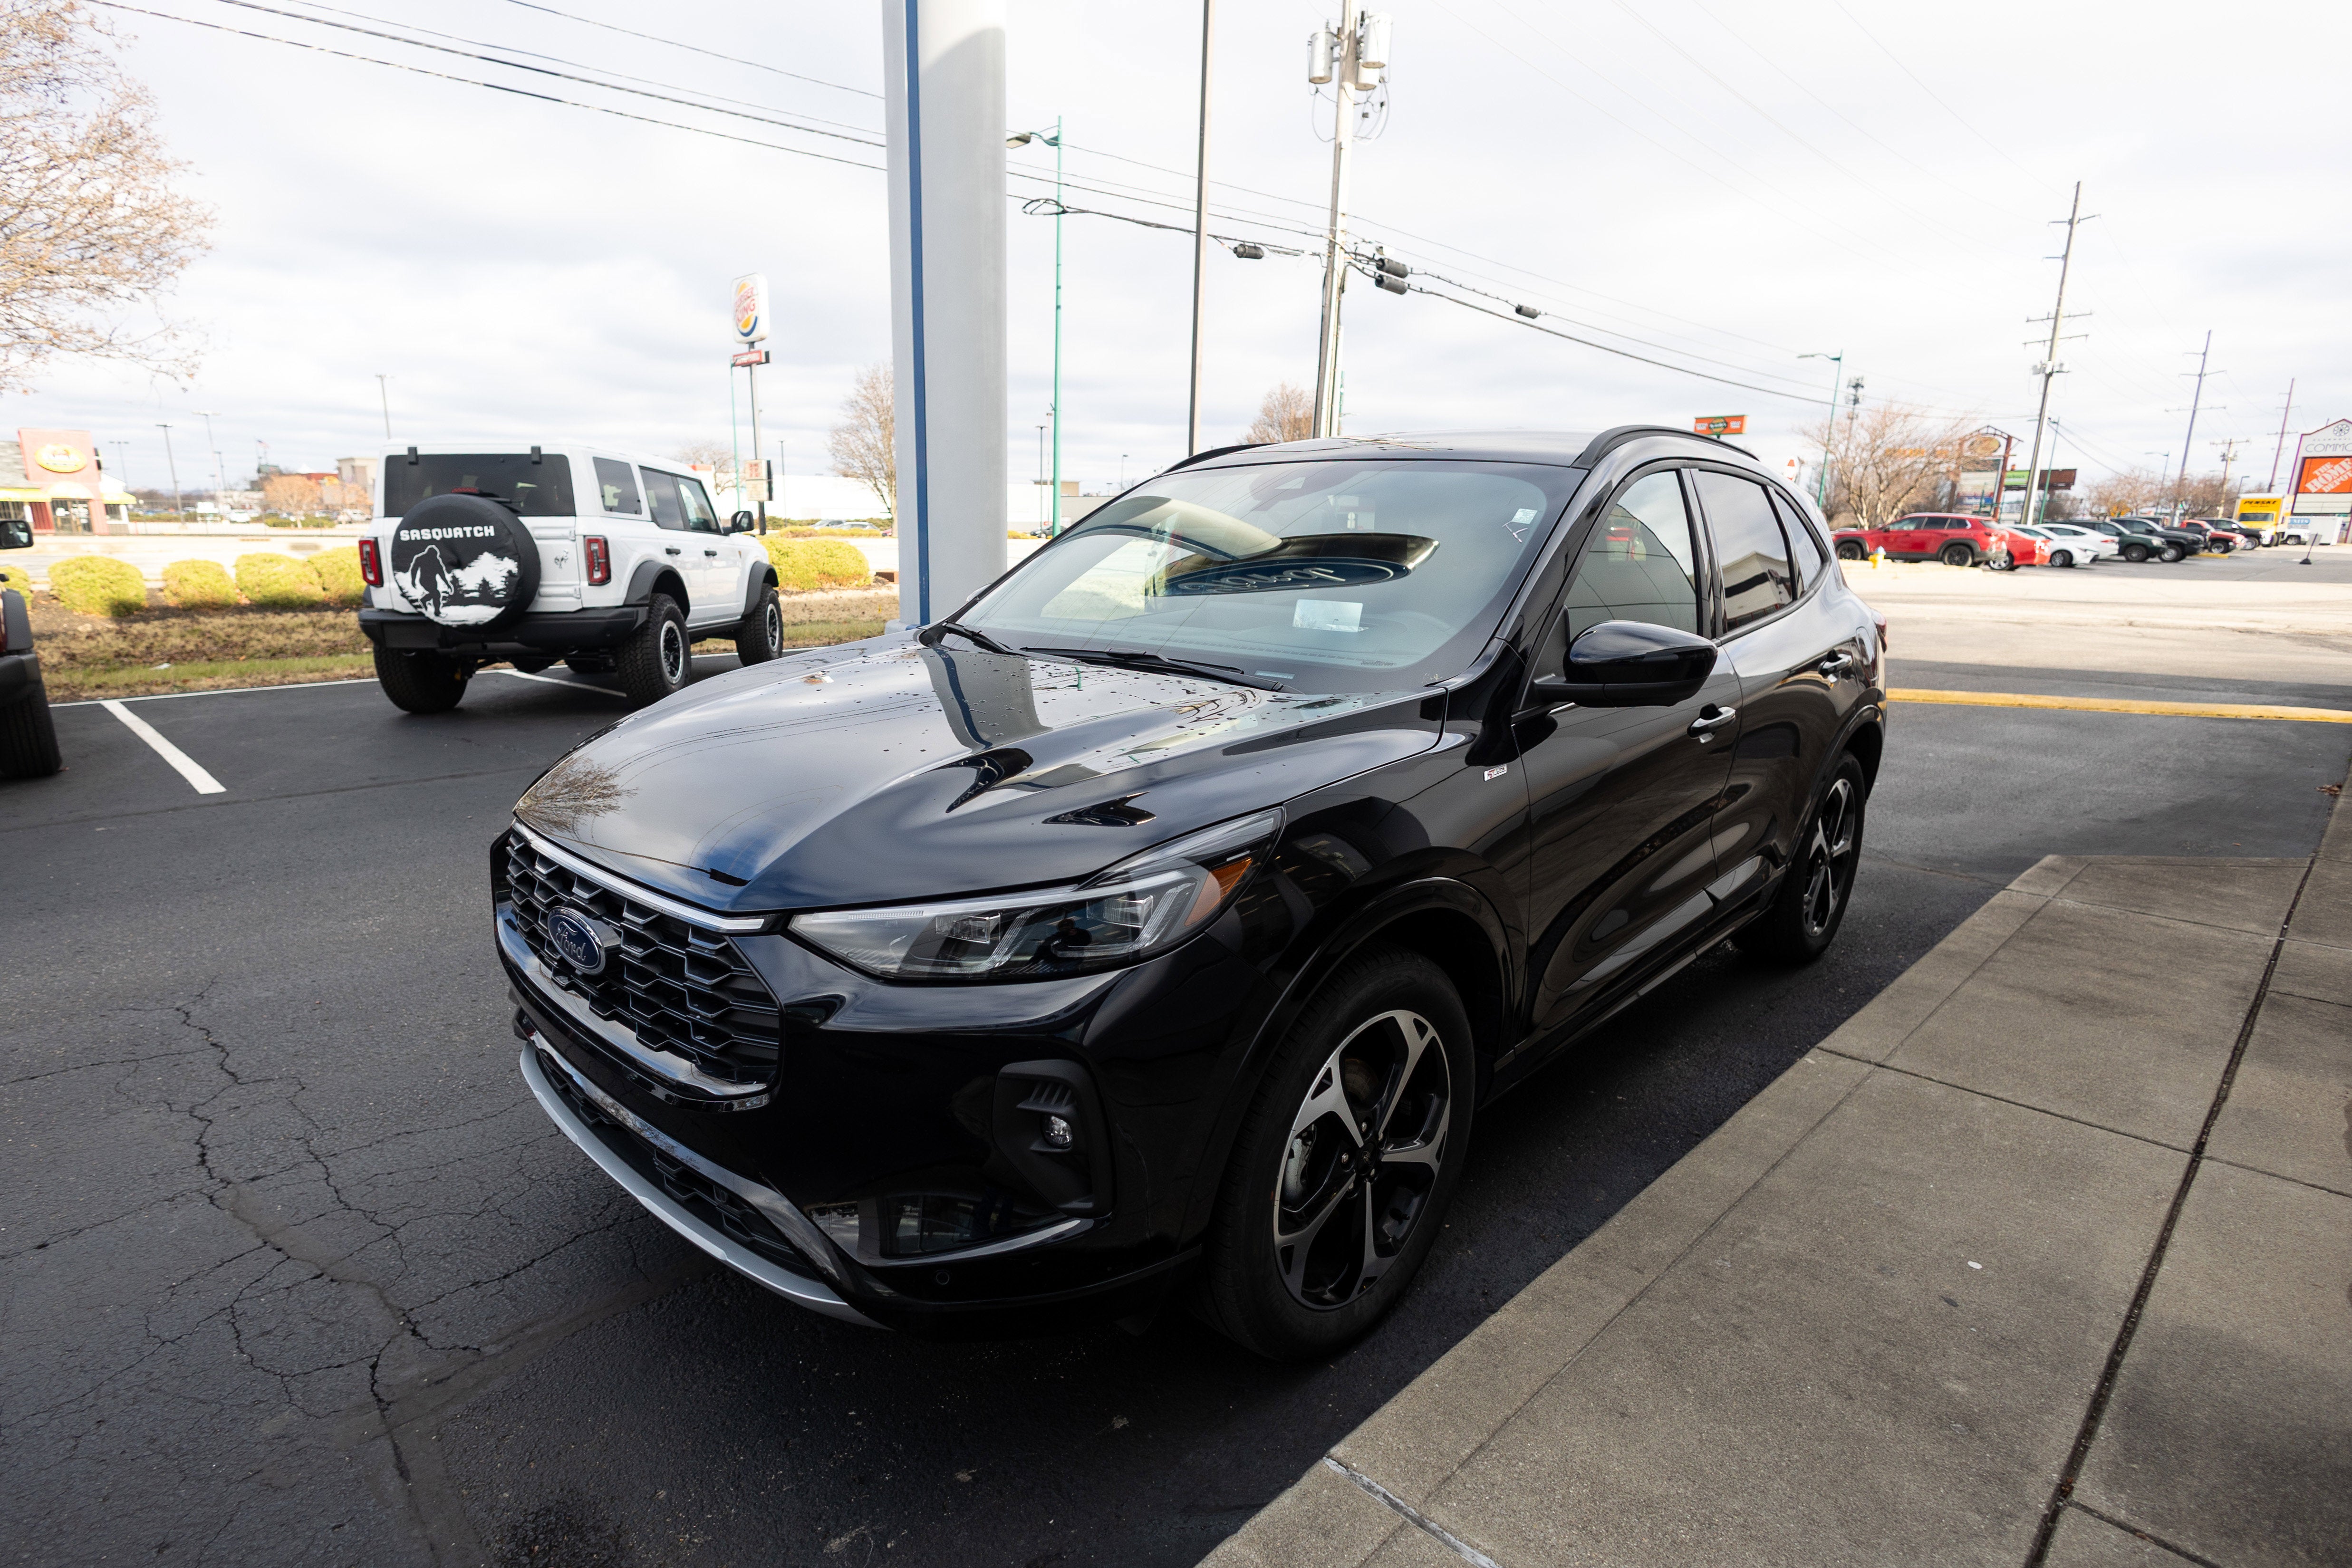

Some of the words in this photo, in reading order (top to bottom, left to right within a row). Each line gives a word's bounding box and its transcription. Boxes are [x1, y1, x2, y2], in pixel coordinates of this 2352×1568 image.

[2305, 458, 2352, 493] HOME
[400, 526, 494, 541] SASQUATCH
[556, 921, 587, 962] Ford
